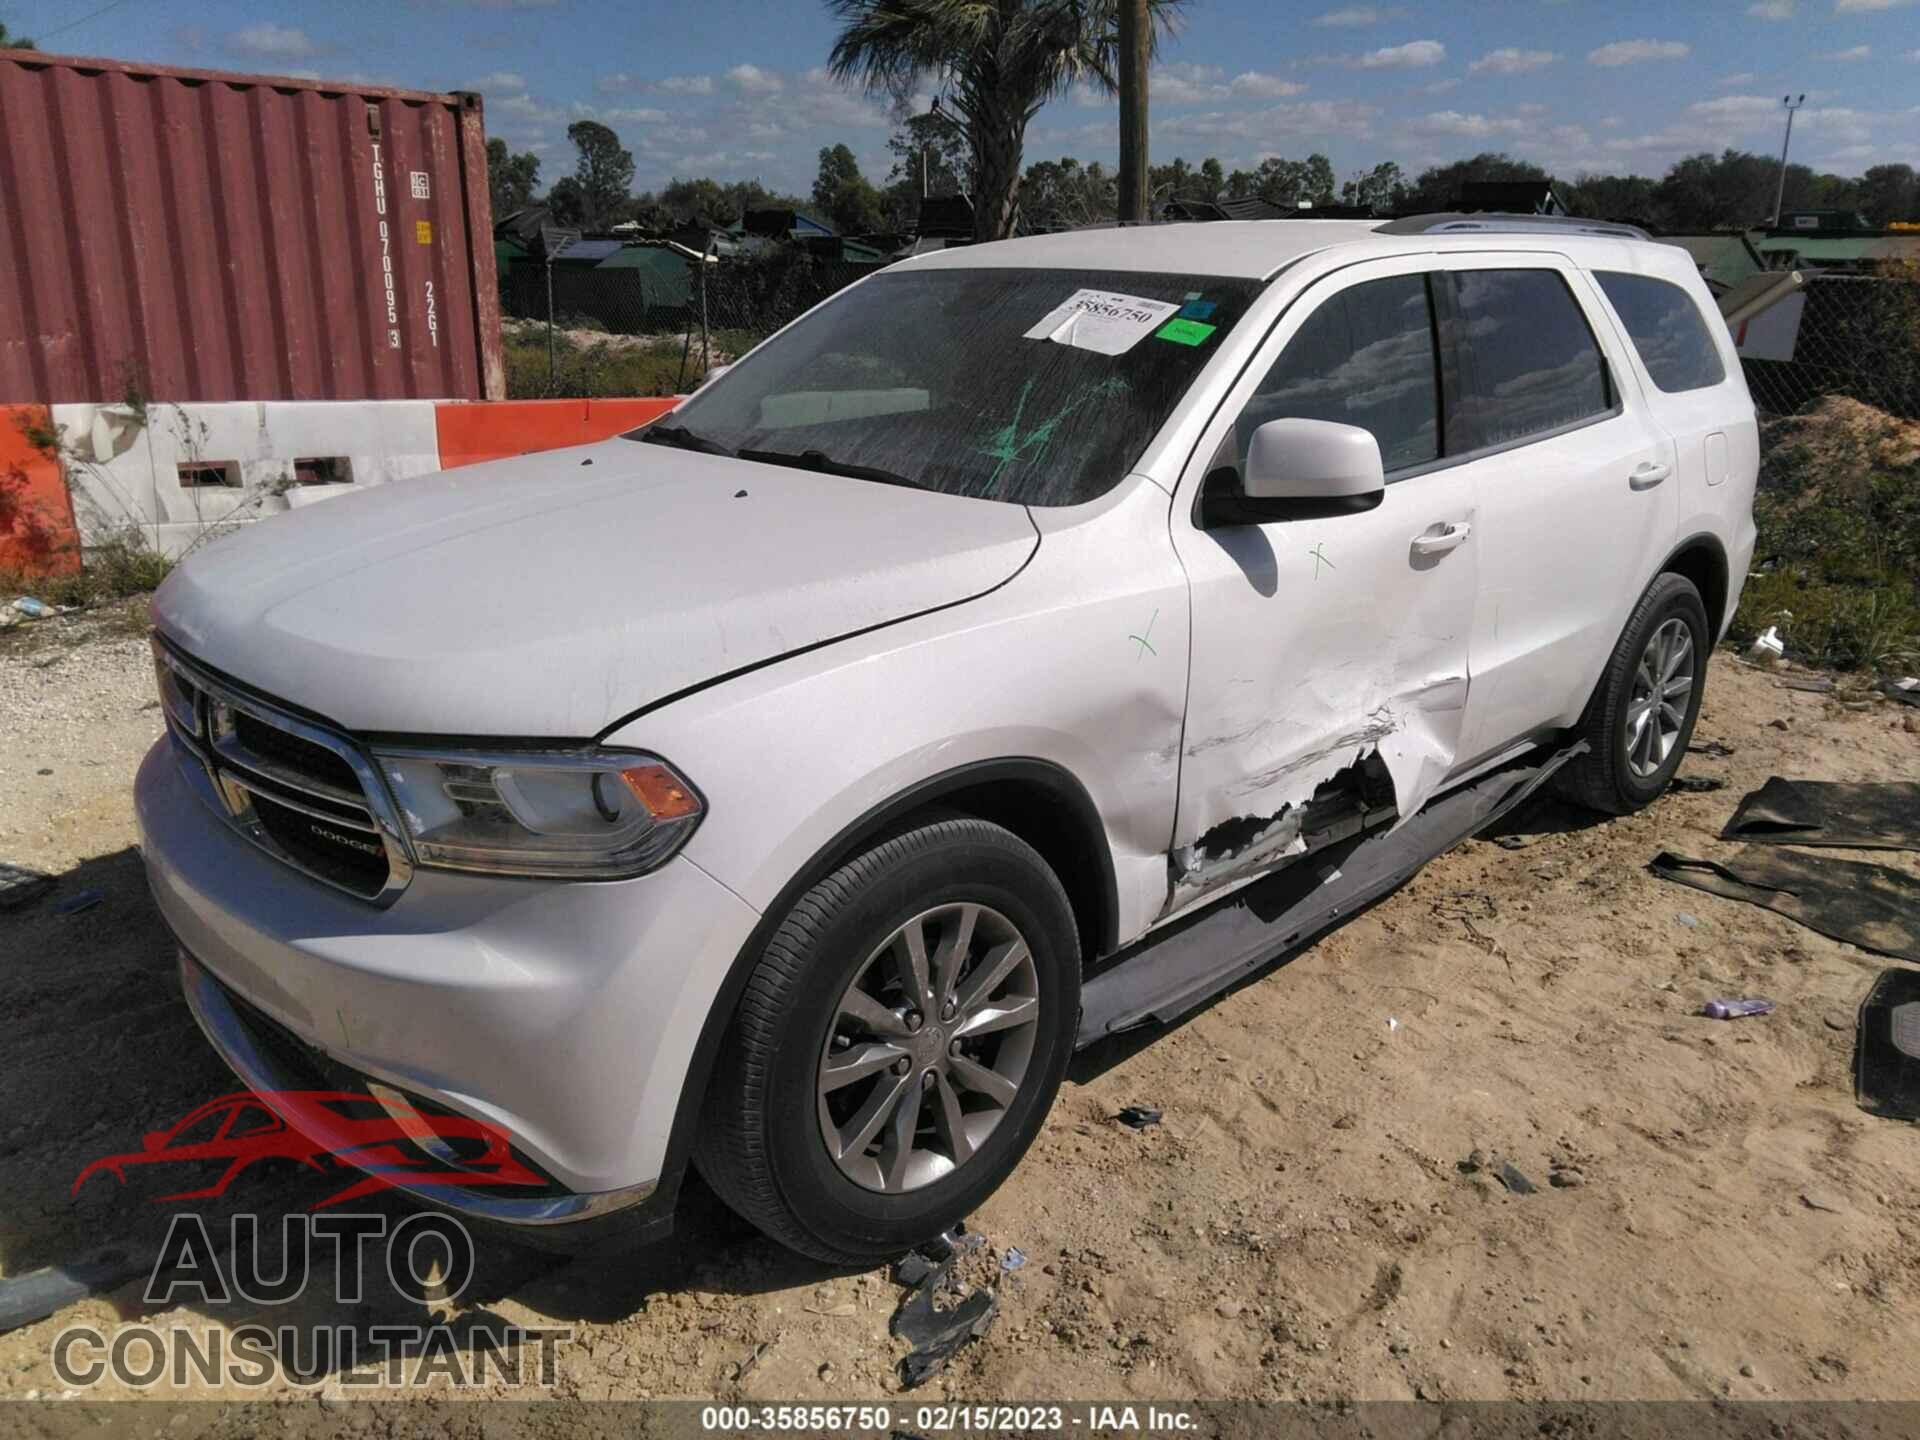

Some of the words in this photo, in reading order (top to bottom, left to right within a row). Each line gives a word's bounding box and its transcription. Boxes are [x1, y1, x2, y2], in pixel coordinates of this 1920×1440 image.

[371, 144, 387, 214] TGHU
[379, 220, 397, 323] 070095
[425, 280, 437, 347] 22G1
